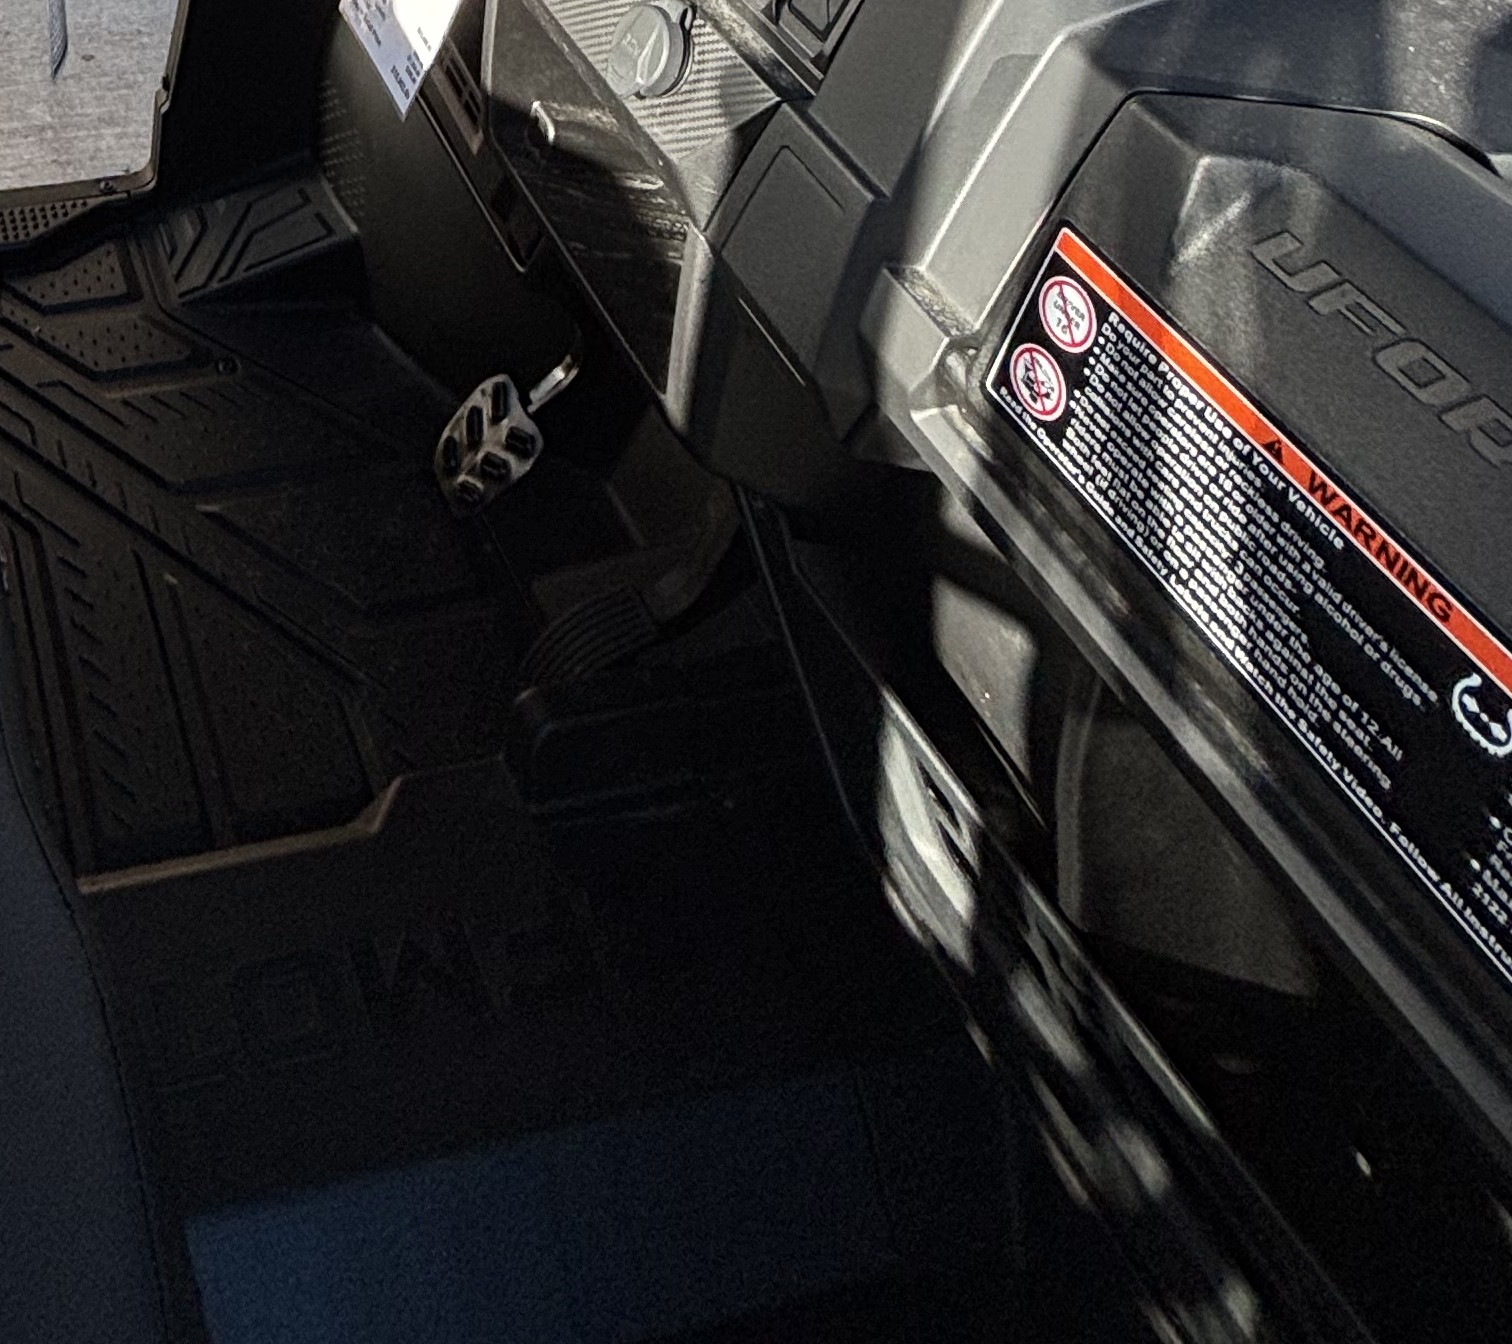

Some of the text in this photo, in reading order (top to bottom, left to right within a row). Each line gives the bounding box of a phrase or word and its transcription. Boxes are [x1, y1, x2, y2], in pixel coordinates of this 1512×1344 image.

[1078, 394, 1094, 414] Do
[1092, 411, 1111, 432] not
[1109, 429, 1146, 469] exceed
[1145, 467, 1185, 513] seating
[1233, 559, 1244, 575] 3
[1083, 385, 1300, 618] collisions with cars and trucks can occur.
[1088, 372, 1105, 393] Do
[1103, 390, 1123, 412] not
[1121, 409, 1151, 440] allow
[1150, 439, 1204, 497] operation
[1202, 493, 1220, 514] on
[1217, 510, 1255, 551] public
[1098, 352, 1126, 383] Make
[1125, 380, 1148, 407] sure
[1148, 404, 1198, 457] operators
[1196, 453, 1217, 477] are
[1214, 470, 1235, 495] 16
[1230, 488, 1246, 504] or
[1244, 502, 1276, 535] older
[1275, 533, 1301, 562] with
[1300, 560, 1311, 574] a
[1311, 569, 1342, 604] valid
[1341, 600, 1388, 653] driver's
[1100, 321, 1117, 342] Do
[1115, 339, 1141, 365] your
[1138, 363, 1163, 389] part
[1162, 383, 1175, 401] to
[1173, 394, 1219, 444] prevent
[1104, 341, 1326, 572] Do not allow careless or reckless driving.
[1106, 311, 1344, 550] Require Proper Use of Your Vehicle
[999, 385, 1023, 414] Read
[1021, 411, 1037, 431] the
[1036, 426, 1085, 486] Operator's
[1084, 480, 1114, 517] Guide
[1114, 514, 1135, 539] and
[1133, 534, 1168, 579] Safety
[1168, 573, 1210, 624] Labels
[1208, 619, 1235, 651] and
[1233, 644, 1273, 695] Watch
[1274, 691, 1296, 720] the
[1293, 717, 1341, 770] Safety
[1342, 766, 1385, 824] Video.
[1388, 821, 1440, 882] Follow
[1439, 882, 1464, 910] All
[1061, 437, 1094, 475] wheel
[1106, 488, 1149, 537] driving)
[1149, 534, 1164, 551] or
[1162, 549, 1179, 570] on
[1178, 566, 1189, 580] a
[1187, 577, 1252, 649] passenger
[1253, 647, 1287, 689] hand
[1286, 685, 1319, 727] hold.
[1064, 425, 1391, 790] Both feet flat on the floor and both hands on the steering
[1069, 417, 1372, 751] riders must be able to sit with backs against the seat.
[1073, 404, 1107, 442] Never
[1106, 441, 1149, 488] operate
[1150, 486, 1175, 517] with
[1173, 513, 1184, 527] a
[1182, 523, 1248, 594] passenger
[1248, 594, 1288, 637] under
[1288, 635, 1311, 663] the
[1312, 663, 1341, 695] age
[1341, 693, 1359, 712] of
[1093, 362, 1422, 708] Do not let people drive or ride after using alcohol or drugs.
[1306, 470, 1455, 624] WARNING
